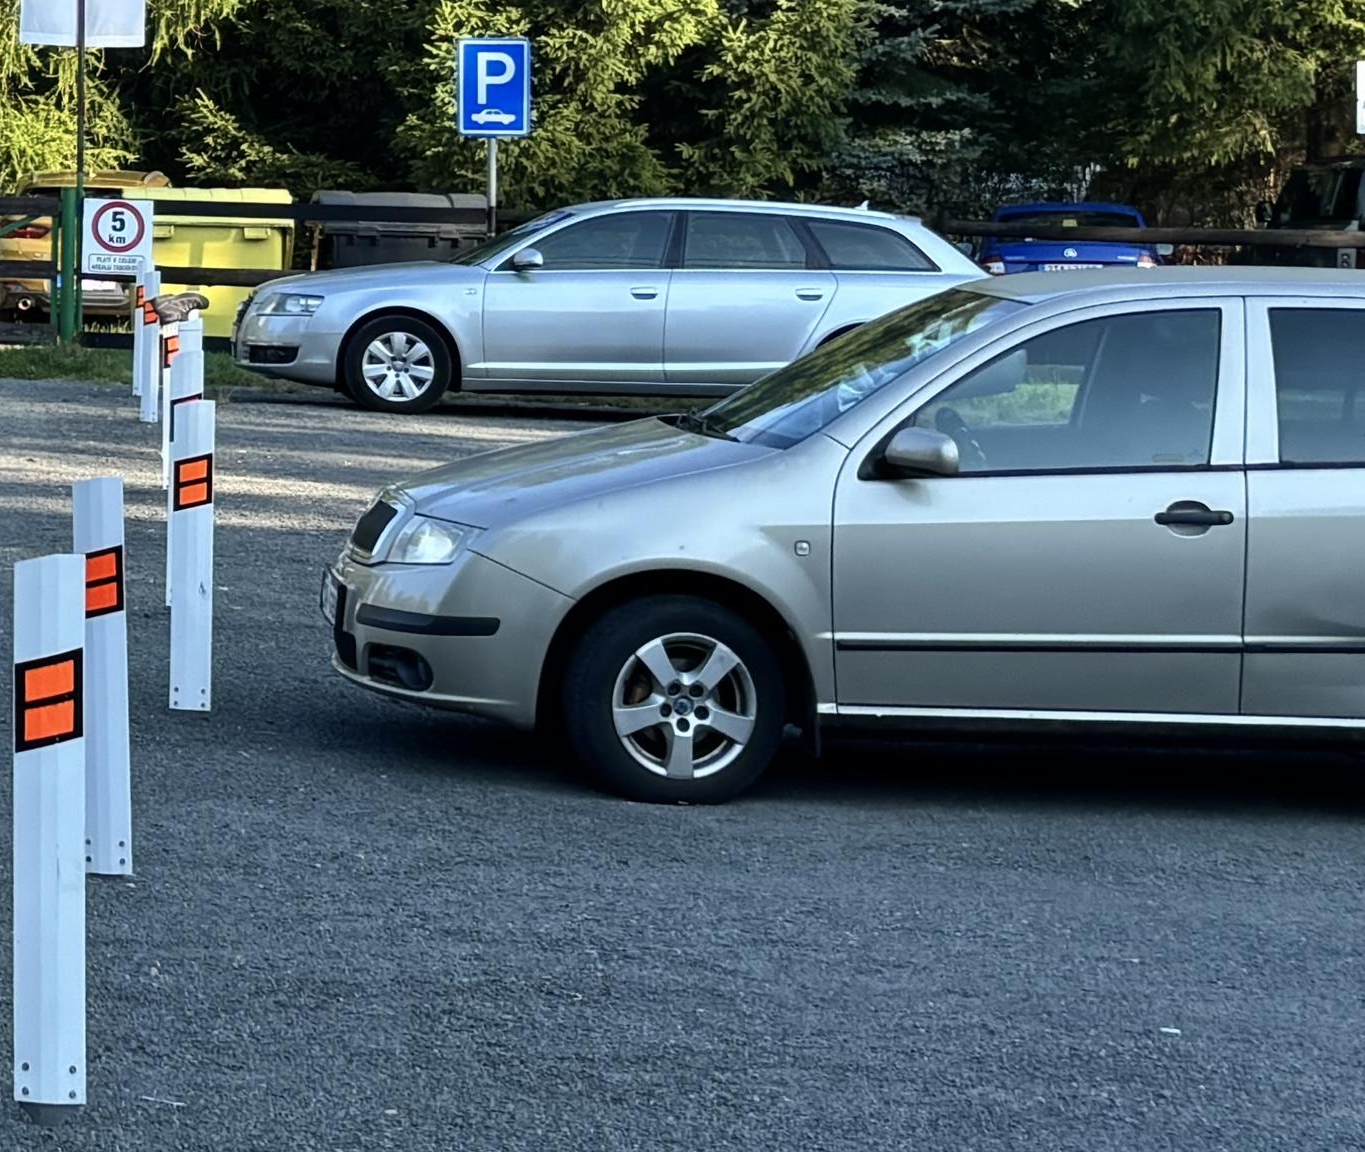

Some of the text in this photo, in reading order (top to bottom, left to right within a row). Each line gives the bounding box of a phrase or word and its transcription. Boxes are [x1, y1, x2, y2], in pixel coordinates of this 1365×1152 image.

[477, 51, 516, 105] P
[111, 211, 126, 232] 5
[108, 234, 126, 244] km
